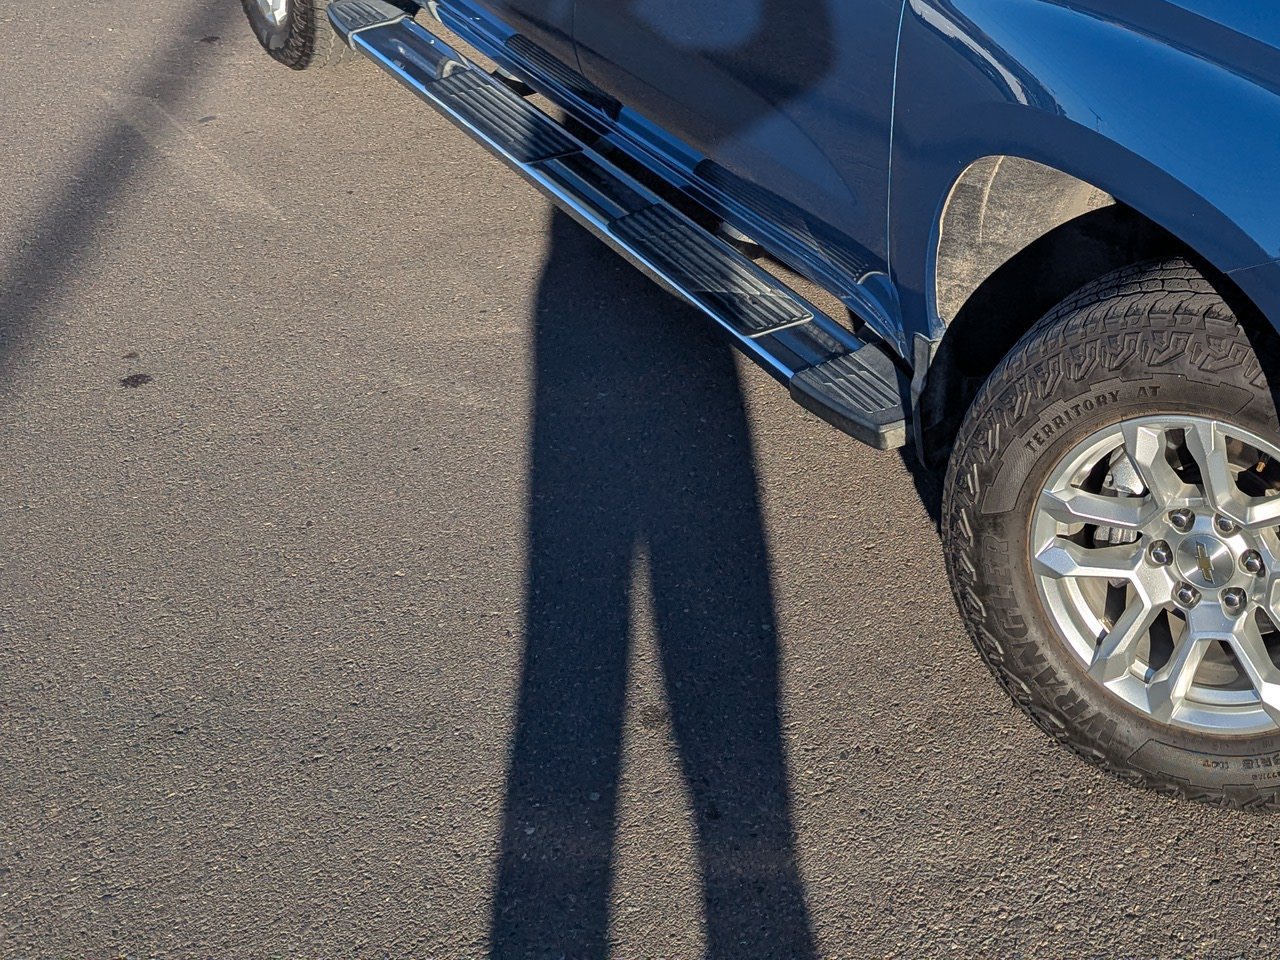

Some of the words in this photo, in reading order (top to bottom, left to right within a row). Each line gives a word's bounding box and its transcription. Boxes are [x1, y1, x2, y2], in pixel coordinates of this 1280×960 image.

[1023, 390, 1121, 454] TERRITORY
[1136, 385, 1161, 399] AT
[983, 535, 1119, 740] WRANGLER
